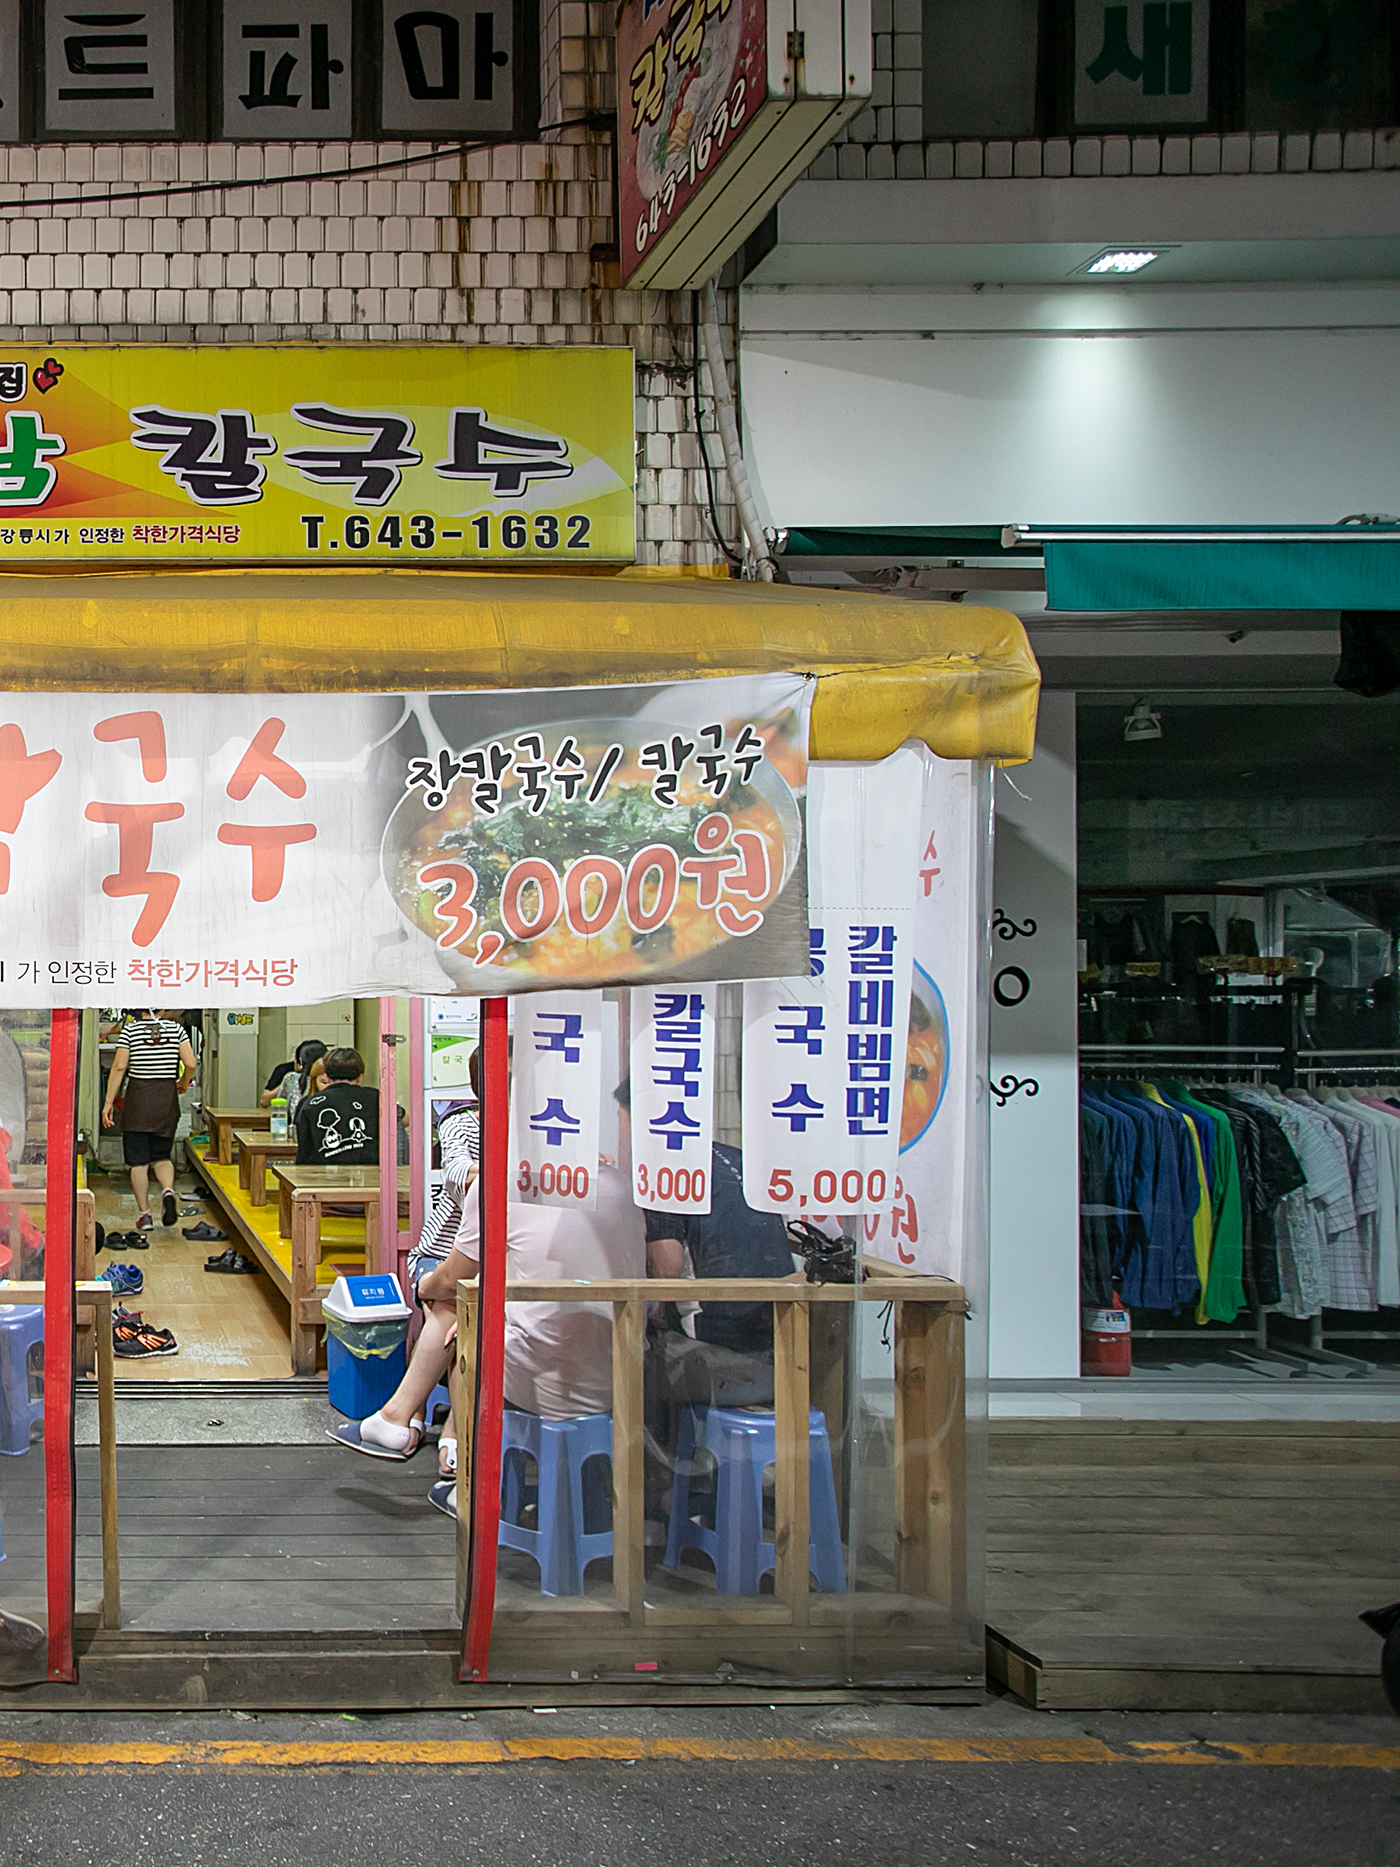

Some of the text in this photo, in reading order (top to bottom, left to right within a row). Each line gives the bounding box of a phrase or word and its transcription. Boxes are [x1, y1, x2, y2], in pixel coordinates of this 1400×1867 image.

[635, 75, 746, 253] 643-1632
[129, 403, 576, 507] 칼국수
[79, 527, 125, 544] 인정한
[131, 525, 241, 544] 착한가격식당
[301, 515, 592, 550] T.643-1632
[641, 725, 763, 806] 칼국수
[418, 812, 773, 968] 3,000원
[47, 959, 118, 985] 인정한
[126, 957, 299, 988] 착한가격식당
[845, 925, 898, 1137] 칼비빔면
[648, 993, 706, 1152] 칼국수
[517, 1160, 590, 1201] 3,000
[637, 1162, 706, 1203] 3,000
[767, 1168, 888, 1206] 5,000
